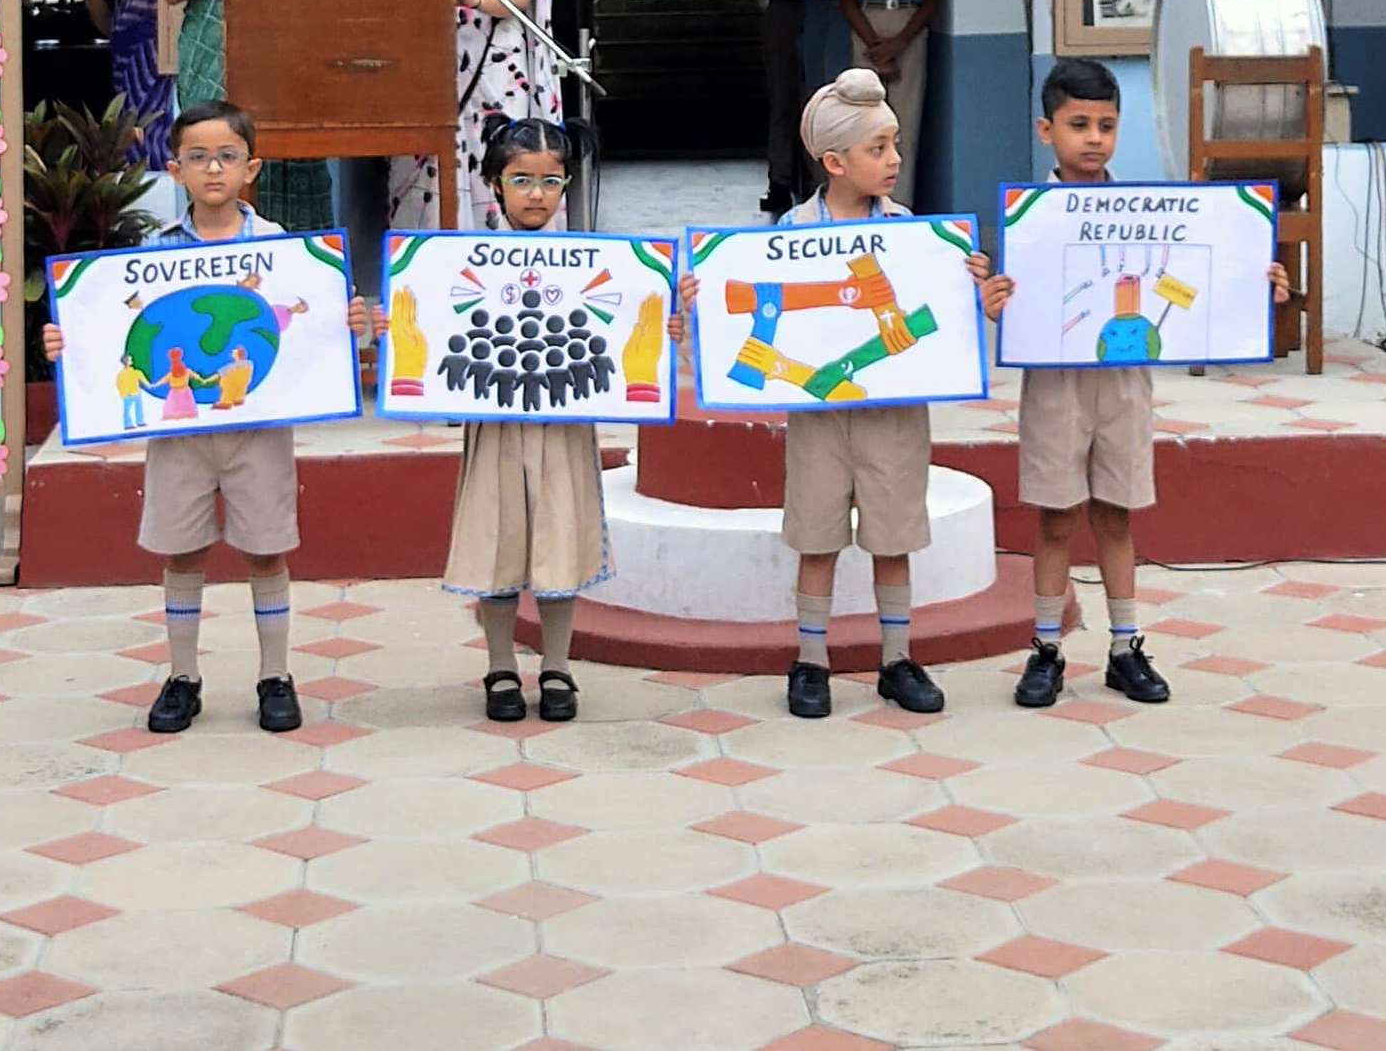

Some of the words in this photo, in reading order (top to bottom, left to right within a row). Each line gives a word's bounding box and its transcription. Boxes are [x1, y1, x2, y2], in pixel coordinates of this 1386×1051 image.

[1066, 192, 1201, 215] DEMOCRATIC
[1079, 221, 1187, 244] REPUBLIC
[467, 243, 601, 269] SOCIALIST
[766, 233, 887, 262] SECULAR
[124, 251, 275, 284] SOVEREIGN
